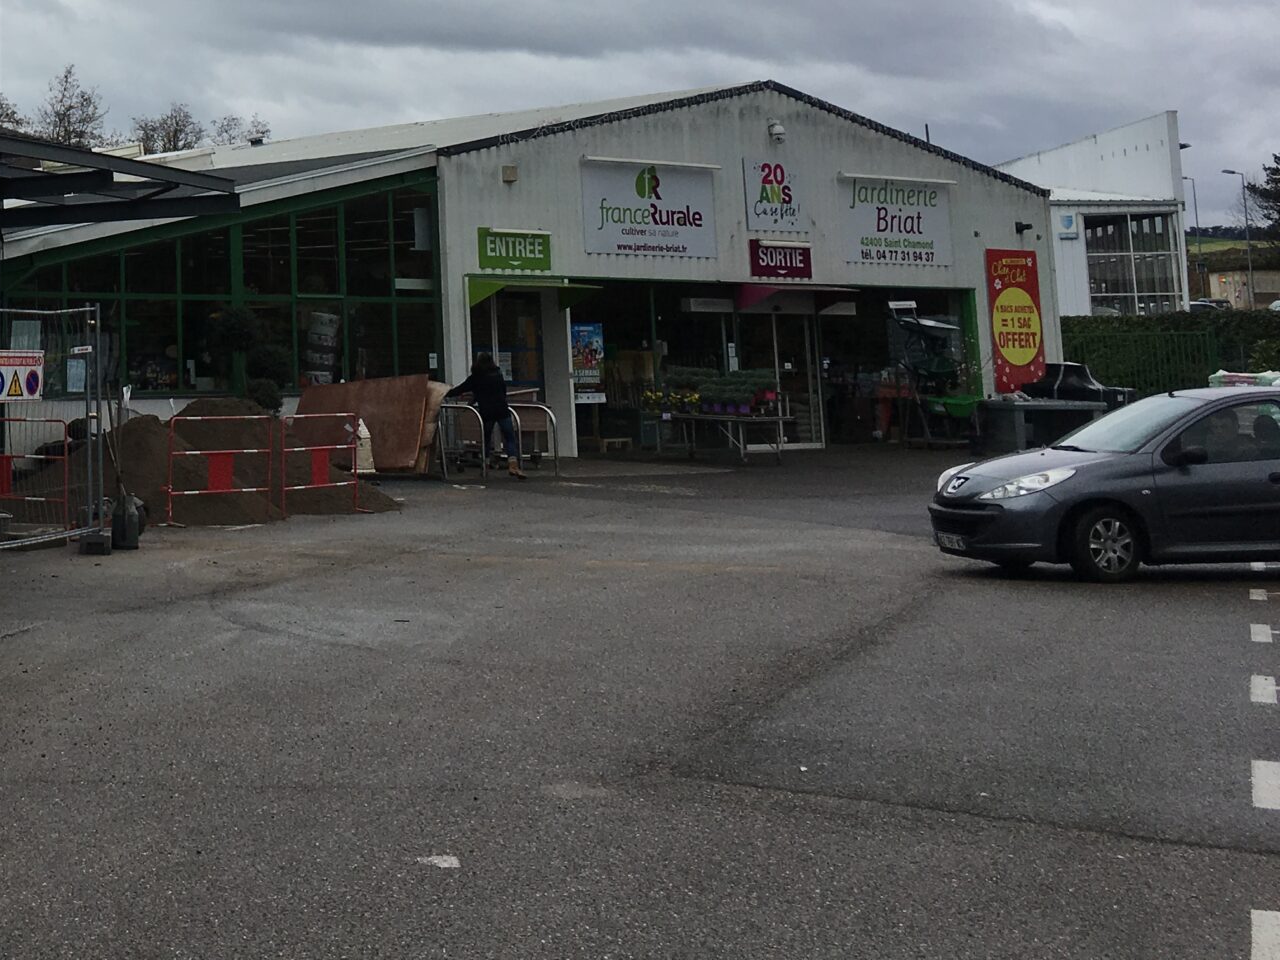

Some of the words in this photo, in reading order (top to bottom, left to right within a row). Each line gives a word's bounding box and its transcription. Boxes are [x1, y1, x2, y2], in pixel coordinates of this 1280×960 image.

[761, 163, 785, 185] 20
[760, 185, 792, 204] ANS
[849, 179, 938, 209] Jardinerie
[769, 206, 779, 216] se
[876, 206, 923, 234] Briat
[621, 227, 647, 237] cultiver
[486, 234, 543, 258] ENTRÉE
[617, 242, 688, 253] www.jardinerie-briat.fr
[860, 236, 883, 247] 42400
[884, 237, 901, 248] Saint
[903, 238, 934, 250] Chamond
[758, 248, 805, 267] SORTIE
[861, 249, 874, 260] tél.
[876, 249, 886, 260] 04
[889, 250, 898, 261] 77
[901, 250, 910, 261] 31
[913, 251, 923, 262] 94
[925, 251, 934, 262] 37
[998, 331, 1037, 349] OFFERT
